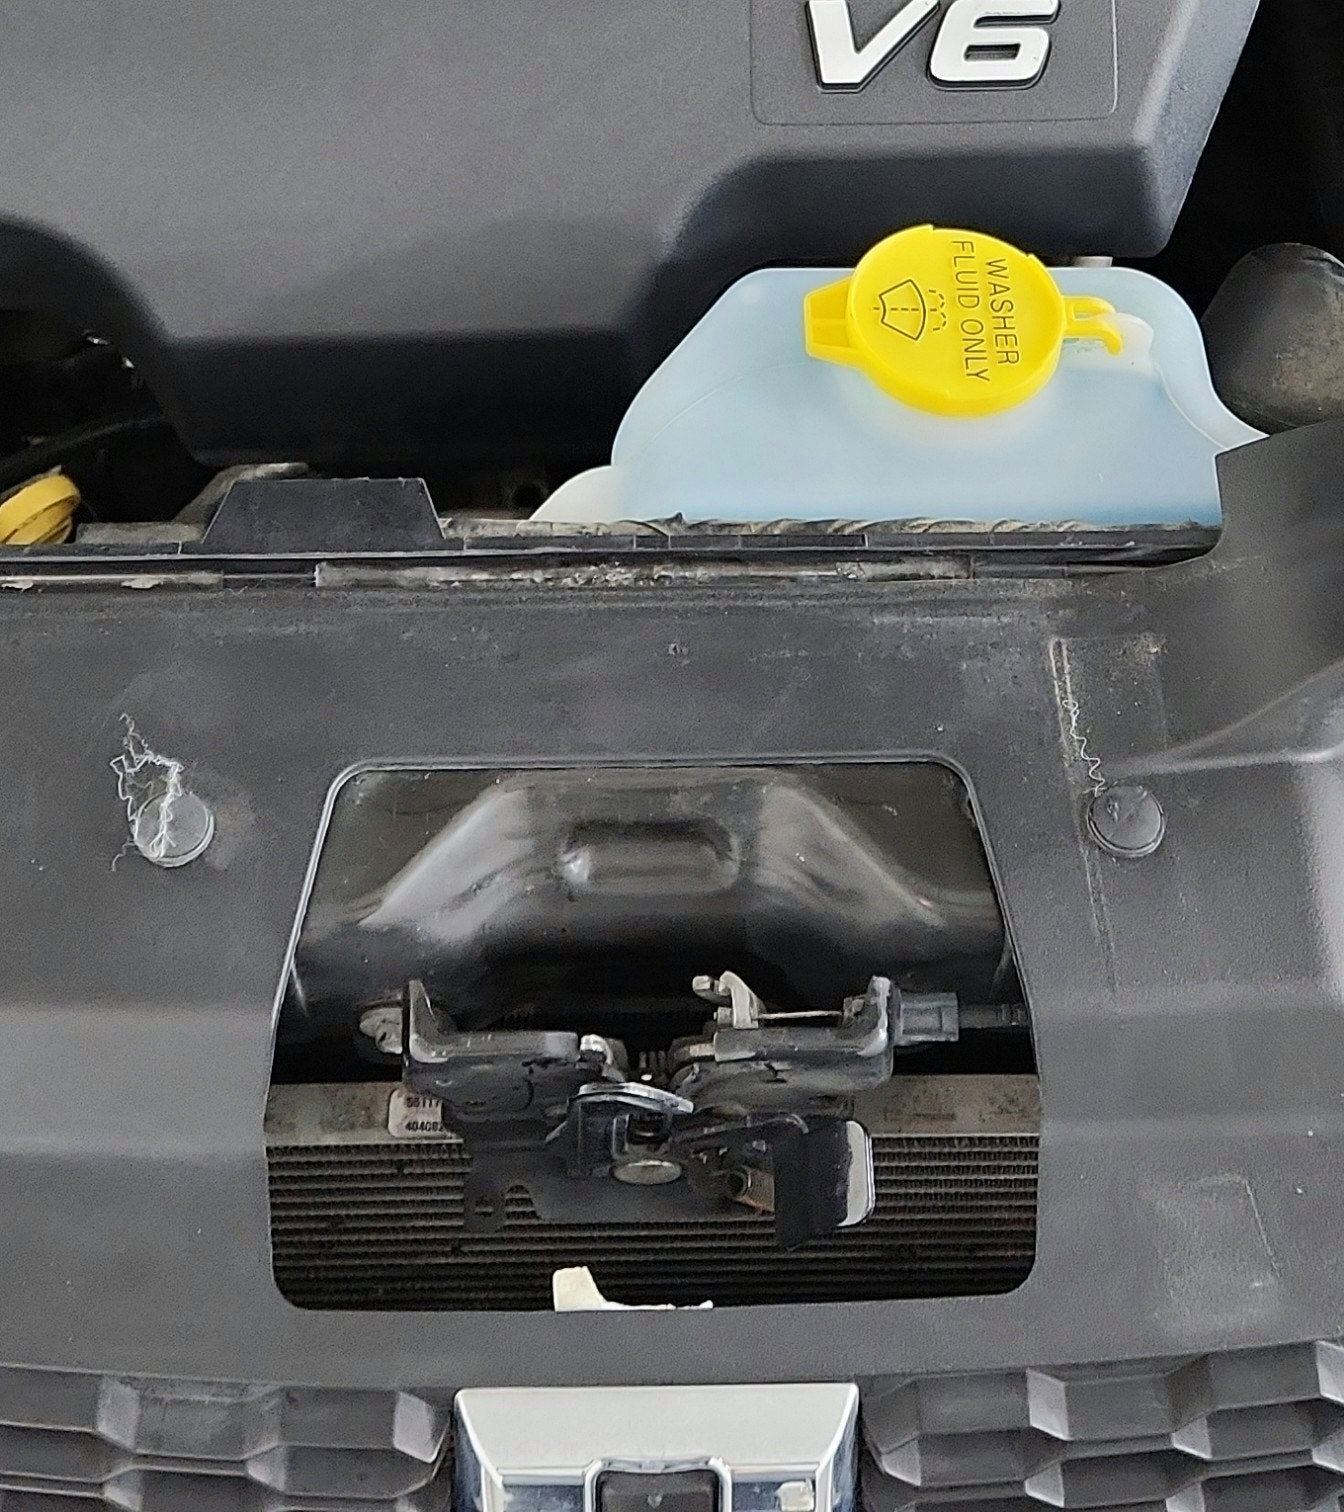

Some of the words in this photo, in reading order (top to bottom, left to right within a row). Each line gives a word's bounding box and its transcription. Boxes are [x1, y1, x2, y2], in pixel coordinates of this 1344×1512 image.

[950, 239, 980, 310] FLUID
[984, 257, 1020, 366] WASHER
[959, 319, 991, 383] ONLY
